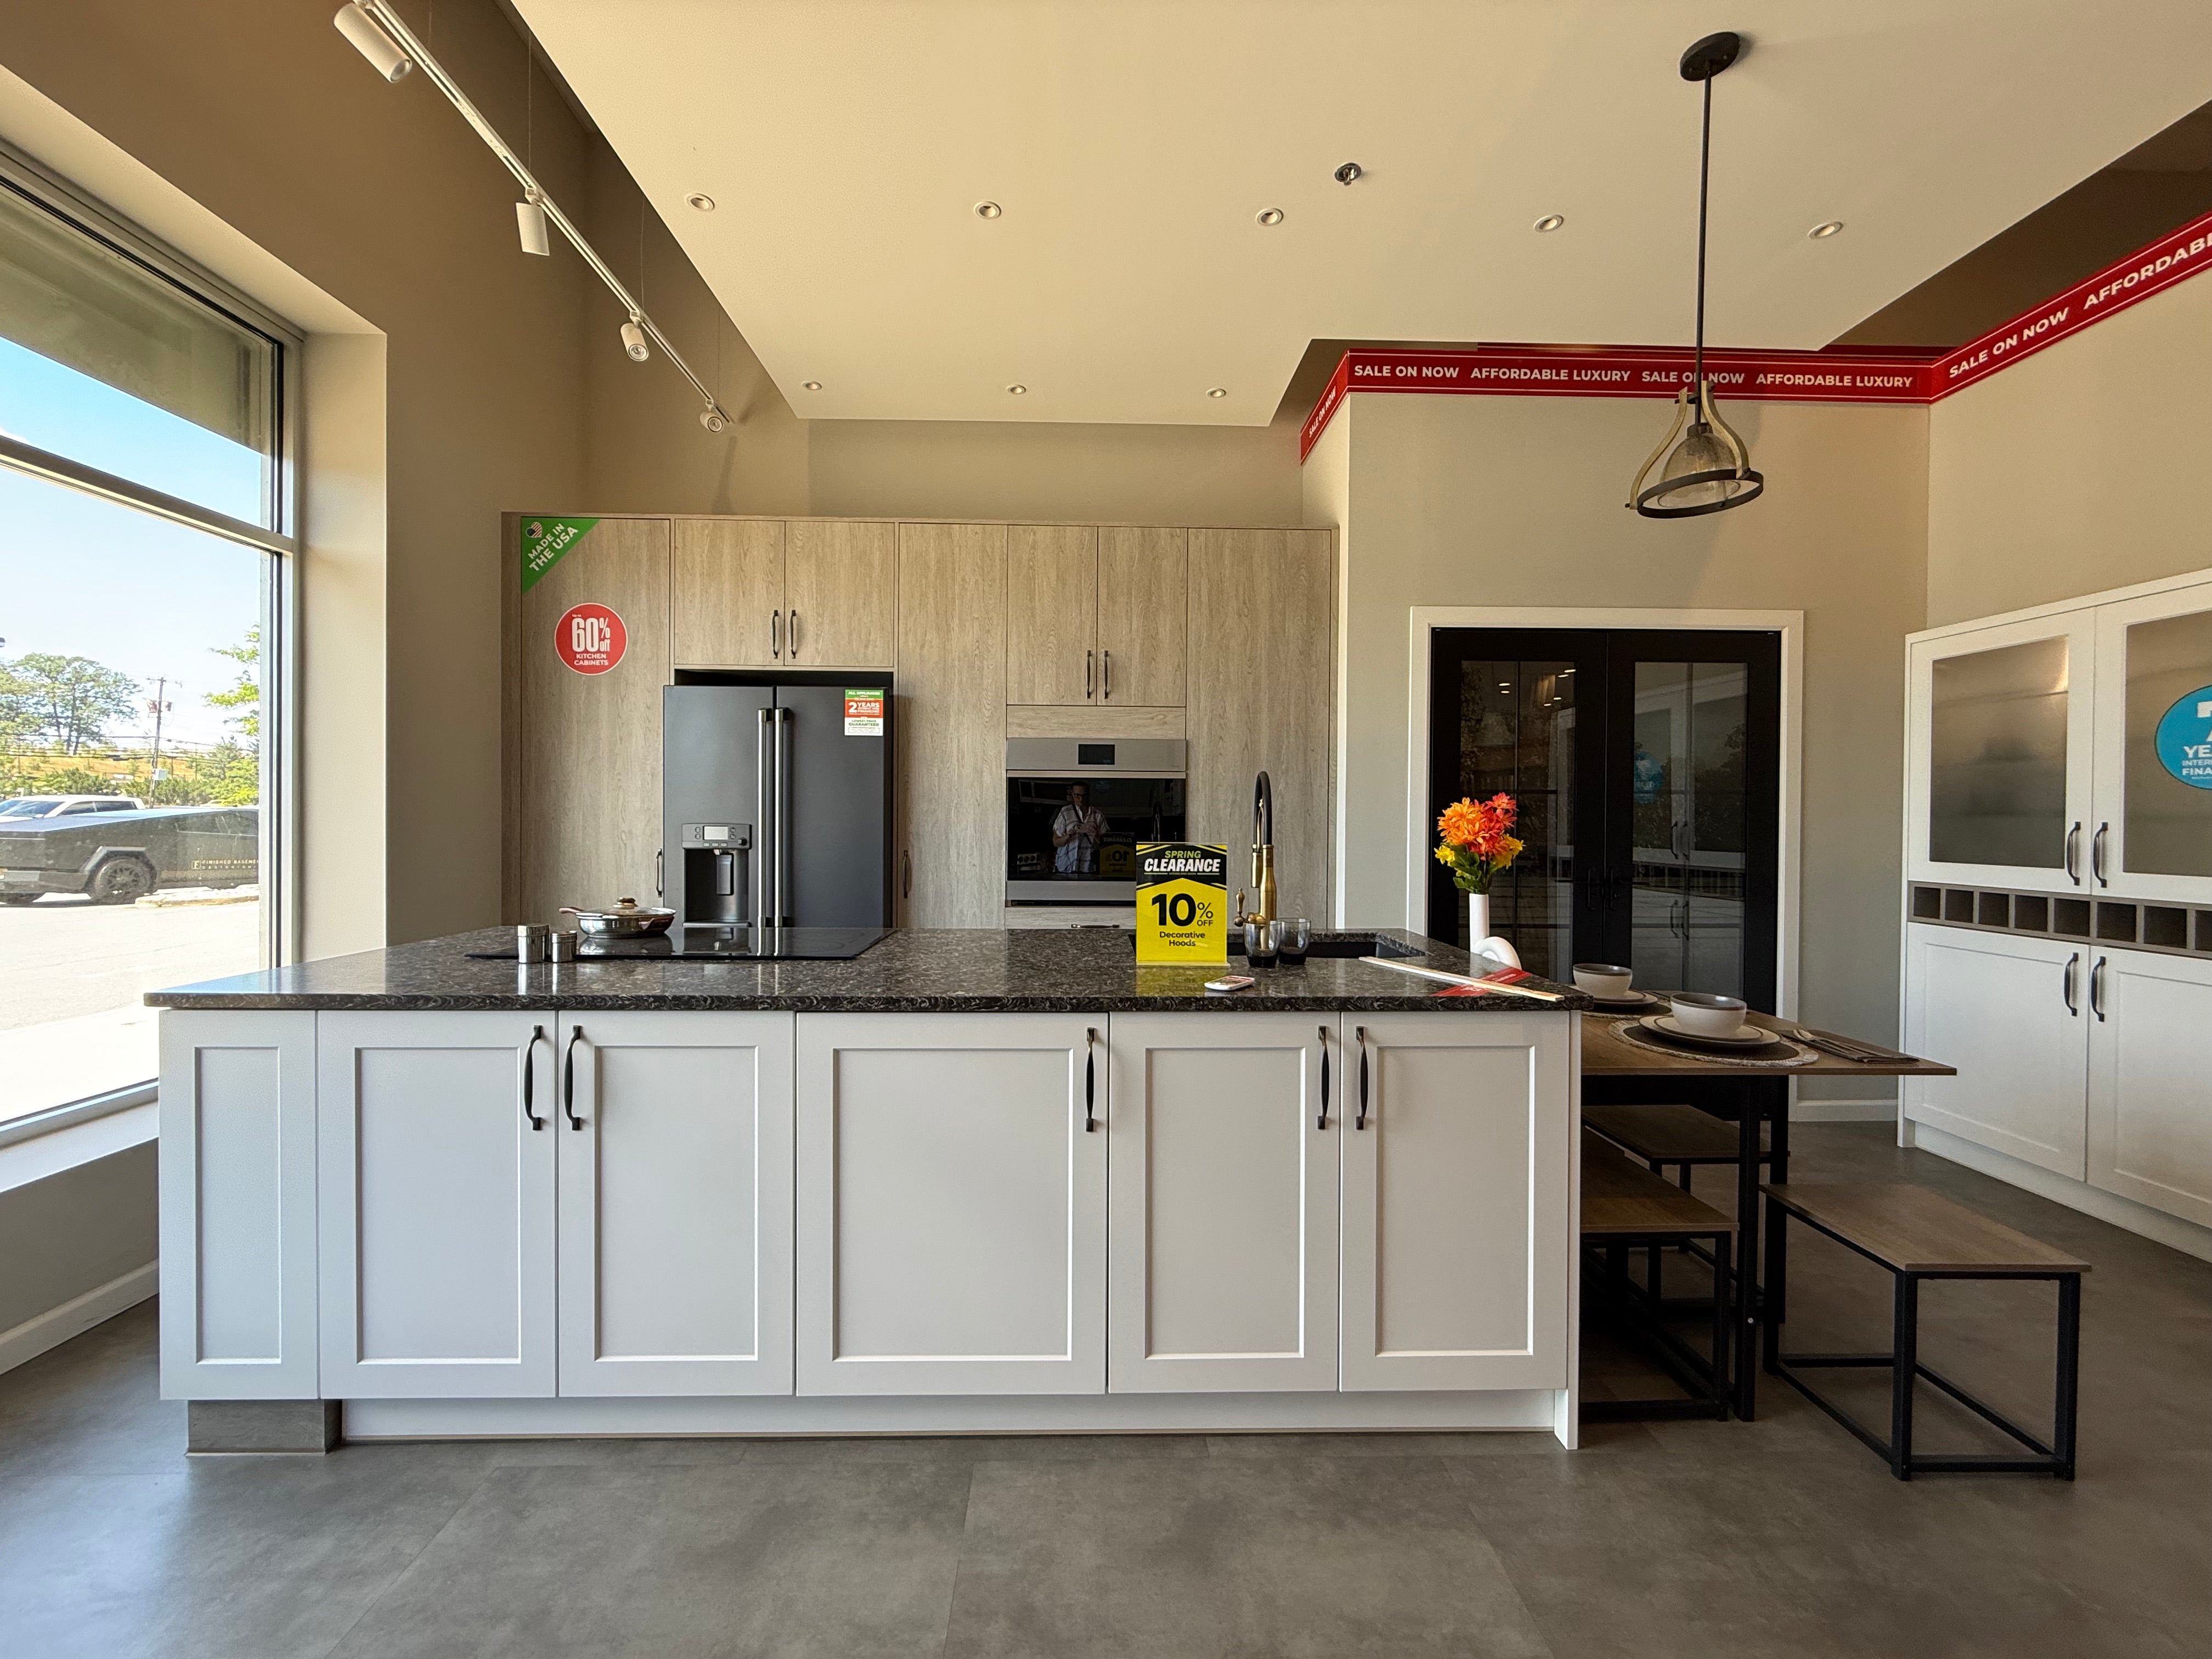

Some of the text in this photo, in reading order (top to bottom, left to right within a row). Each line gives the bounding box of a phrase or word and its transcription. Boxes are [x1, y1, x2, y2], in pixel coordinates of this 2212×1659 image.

[1949, 349, 1988, 379] SALE
[1993, 334, 2018, 356] ON
[2022, 307, 2069, 341] NOW
[1355, 365, 1459, 377] SALE ON NOW
[1470, 368, 1631, 381] AFFORDABLE LUXURY
[1642, 371, 1678, 382] SALE
[1708, 373, 1745, 383] NOW
[1756, 374, 1912, 387] AFFORDABLE LUXURY
[1309, 385, 1336, 438] SALE ON NOW
[528, 523, 565, 559] MADE IN
[529, 527, 578, 571] THE USA
[572, 617, 610, 652] 60%
[600, 639, 611, 652] off
[848, 702, 857, 713] 2
[2183, 745, 2212, 758] YE
[1144, 859, 1221, 872] CLEARANCE
[1152, 893, 1214, 927] 10%
